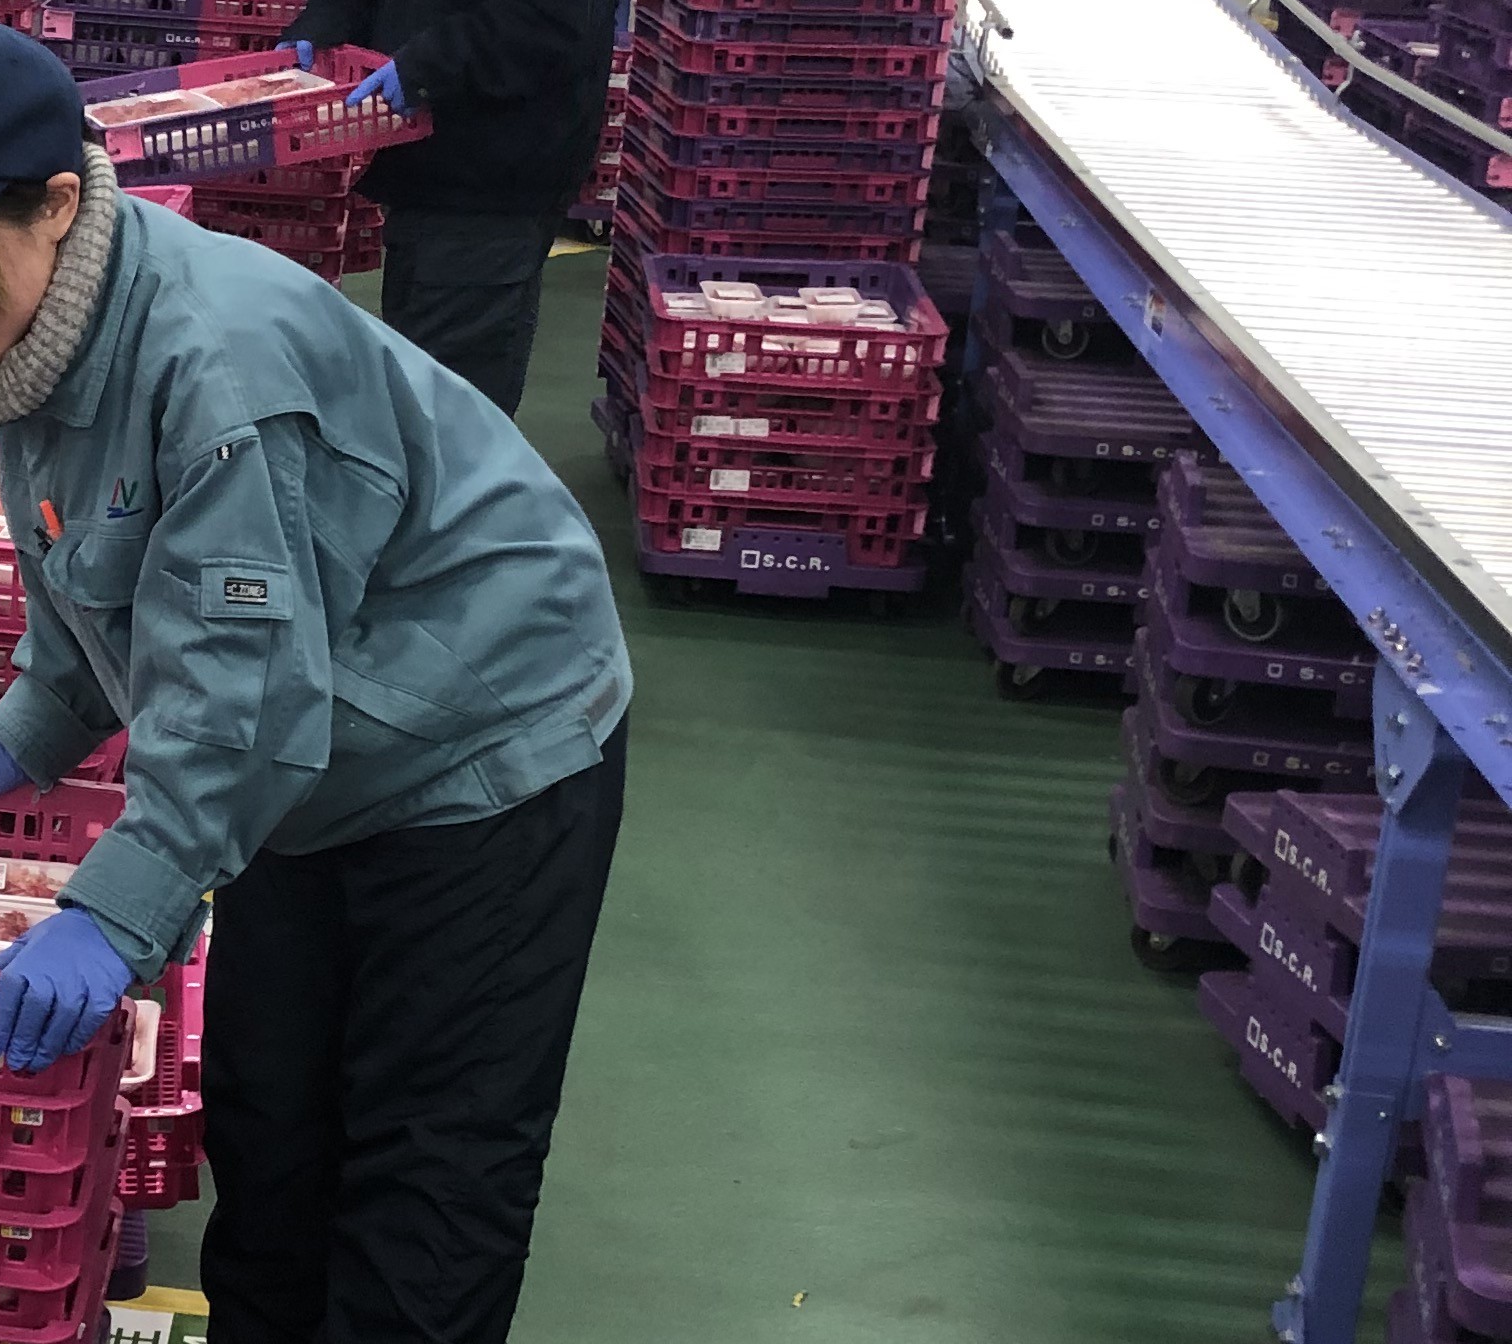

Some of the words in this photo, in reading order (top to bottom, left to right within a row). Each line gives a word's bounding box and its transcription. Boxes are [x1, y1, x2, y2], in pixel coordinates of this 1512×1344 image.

[762, 553, 830, 571] S.C.R.
[1274, 938, 1318, 993] S.C.R.
[1259, 1032, 1302, 1090] S.C.R.
